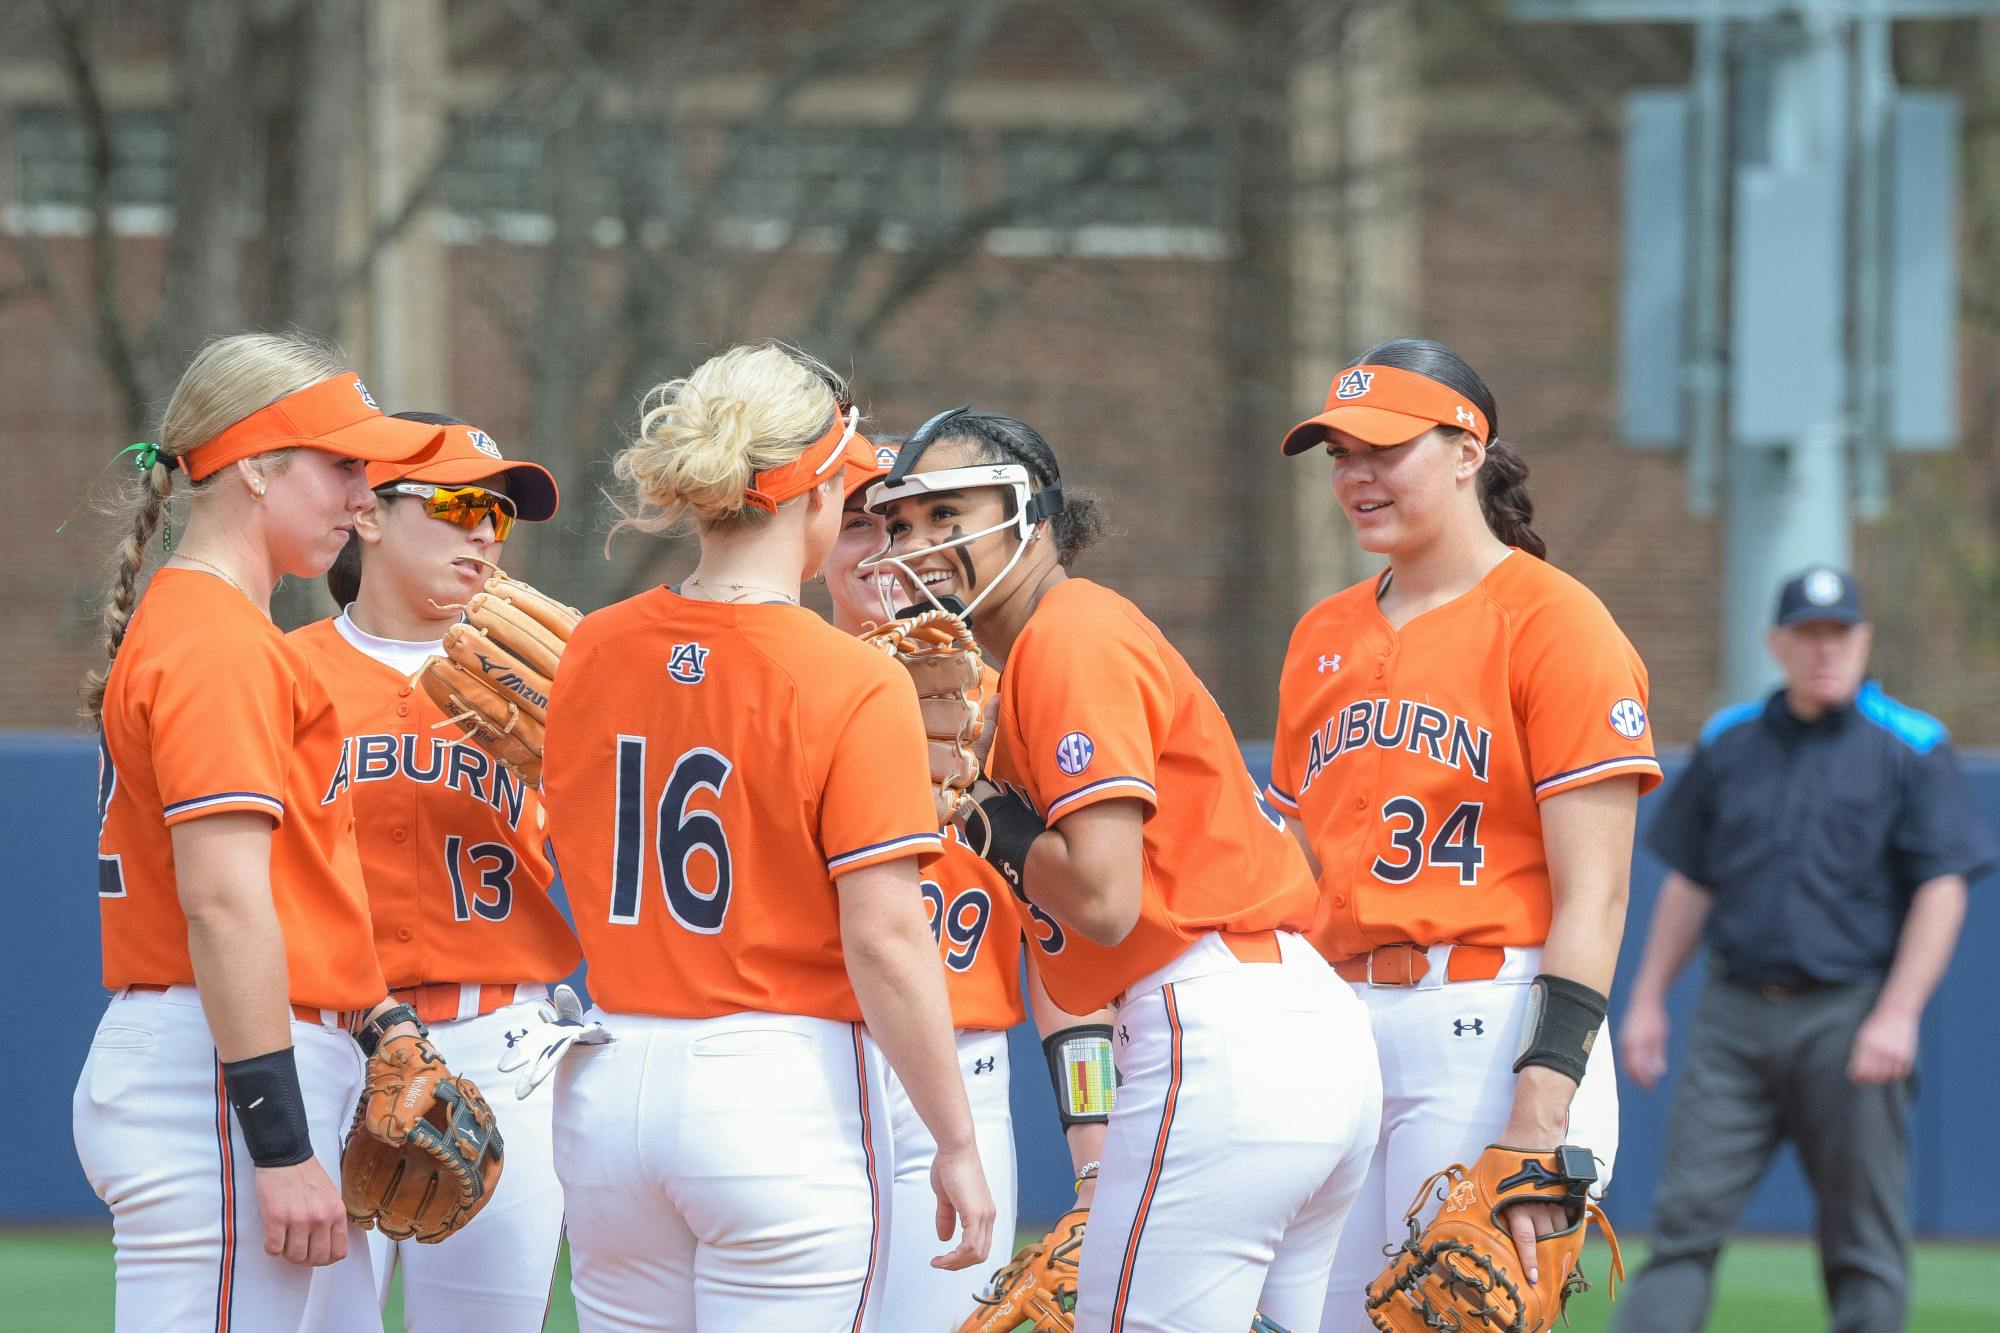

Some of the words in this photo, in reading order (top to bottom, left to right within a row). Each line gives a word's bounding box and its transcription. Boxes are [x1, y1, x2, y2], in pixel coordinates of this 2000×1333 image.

[1055, 731, 1095, 777] SEC
[1299, 698, 1492, 796] AUBURN
[1611, 698, 1645, 738] SEC
[320, 734, 526, 832] ABURN
[445, 835, 517, 922] 13
[608, 733, 733, 935] 16
[1370, 795, 1485, 886] 34
